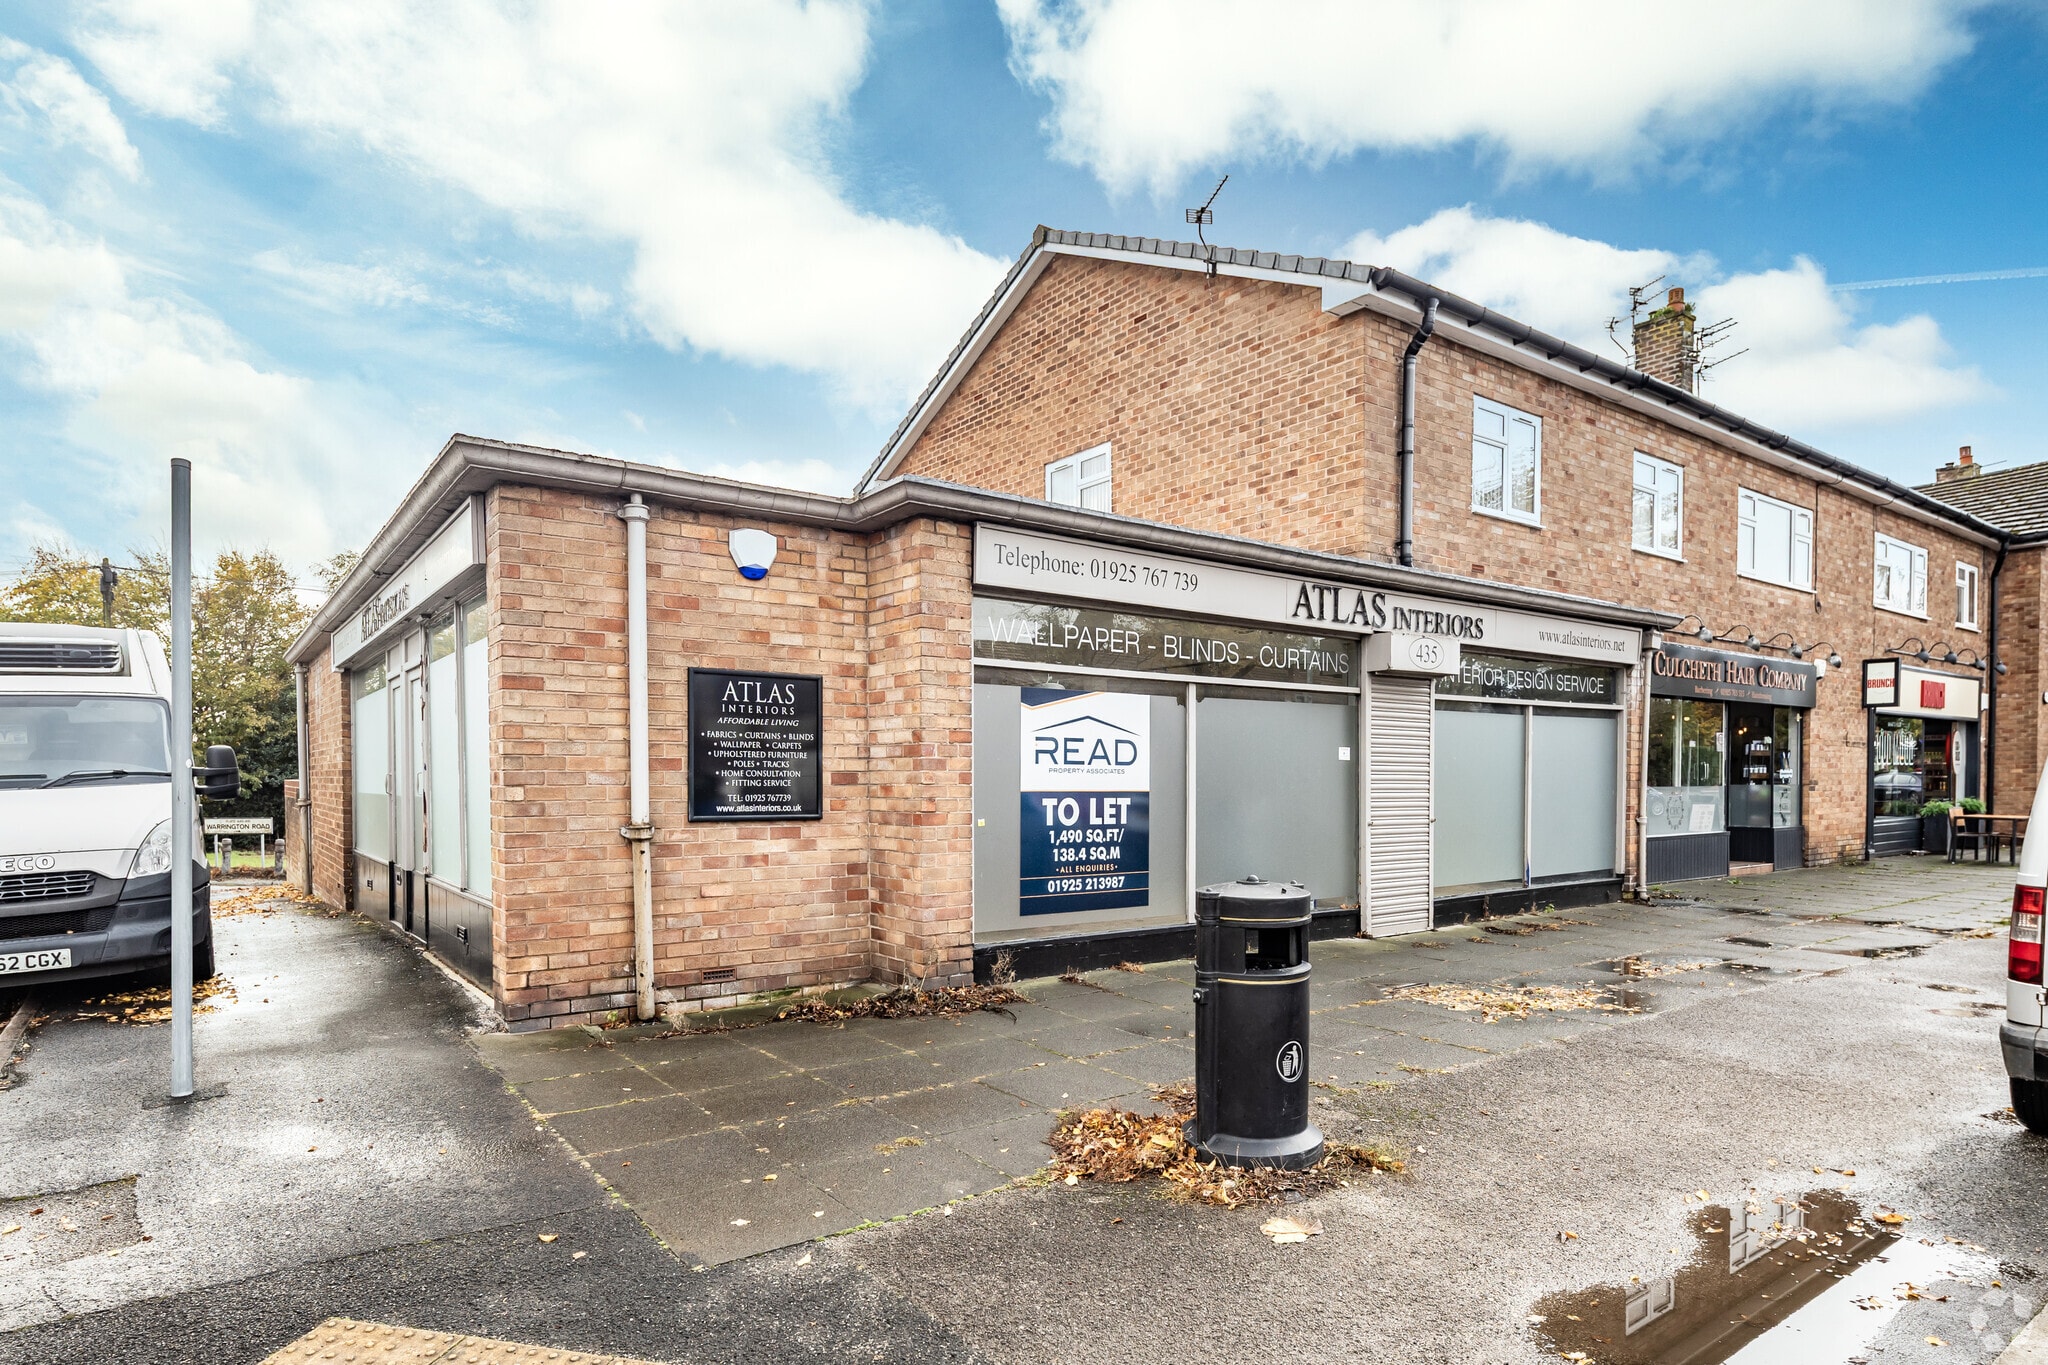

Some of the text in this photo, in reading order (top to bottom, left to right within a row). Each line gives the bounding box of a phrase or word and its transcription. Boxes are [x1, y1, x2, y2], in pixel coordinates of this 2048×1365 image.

[994, 543, 1199, 592] Telephone: 01925 767 739
[1292, 582, 1484, 640] ATLAS INTERIORS
[988, 616, 1140, 655] WALLPAPER
[1164, 635, 1239, 664] BLINDS
[1260, 645, 1350, 674] CURTAINS
[1538, 630, 1625, 652] www.atlasinteriors.net
[1415, 644, 1438, 664] 435
[1654, 650, 1808, 691] CULCHETH HAIR COMPANY
[1507, 669, 1553, 691] DESIGN
[1556, 674, 1605, 694] SERVICE
[1866, 678, 1895, 688] BRUNCH
[721, 680, 796, 705] ATLAS
[722, 703, 795, 715] INTERIORS
[717, 717, 800, 727] AFFORDABLE LIVING
[706, 730, 815, 741] FABRICS CURTAINS BLINDS
[720, 741, 802, 750] WALLPAPER CARPETS
[1034, 736, 1138, 766] READ
[713, 750, 808, 759] UPHOLSTERED FURNITURE
[733, 760, 790, 768] POLES TRACKS
[721, 769, 801, 777] HOME CONSULTATION
[731, 779, 792, 787] FITTING SERVICE
[727, 794, 792, 802] TEL: 01925 767739
[716, 803, 802, 813] www.atlasinteriors.co.uk
[1042, 797, 1131, 827] TO LET
[1048, 828, 1125, 846] 1,490 SQ.FT/
[1052, 846, 1121, 862] 138.4 SQ.M
[1075, 863, 1115, 873] ENQUIRIES
[1047, 876, 1126, 893] 01925 213987
[25, 951, 63, 969] CGX
